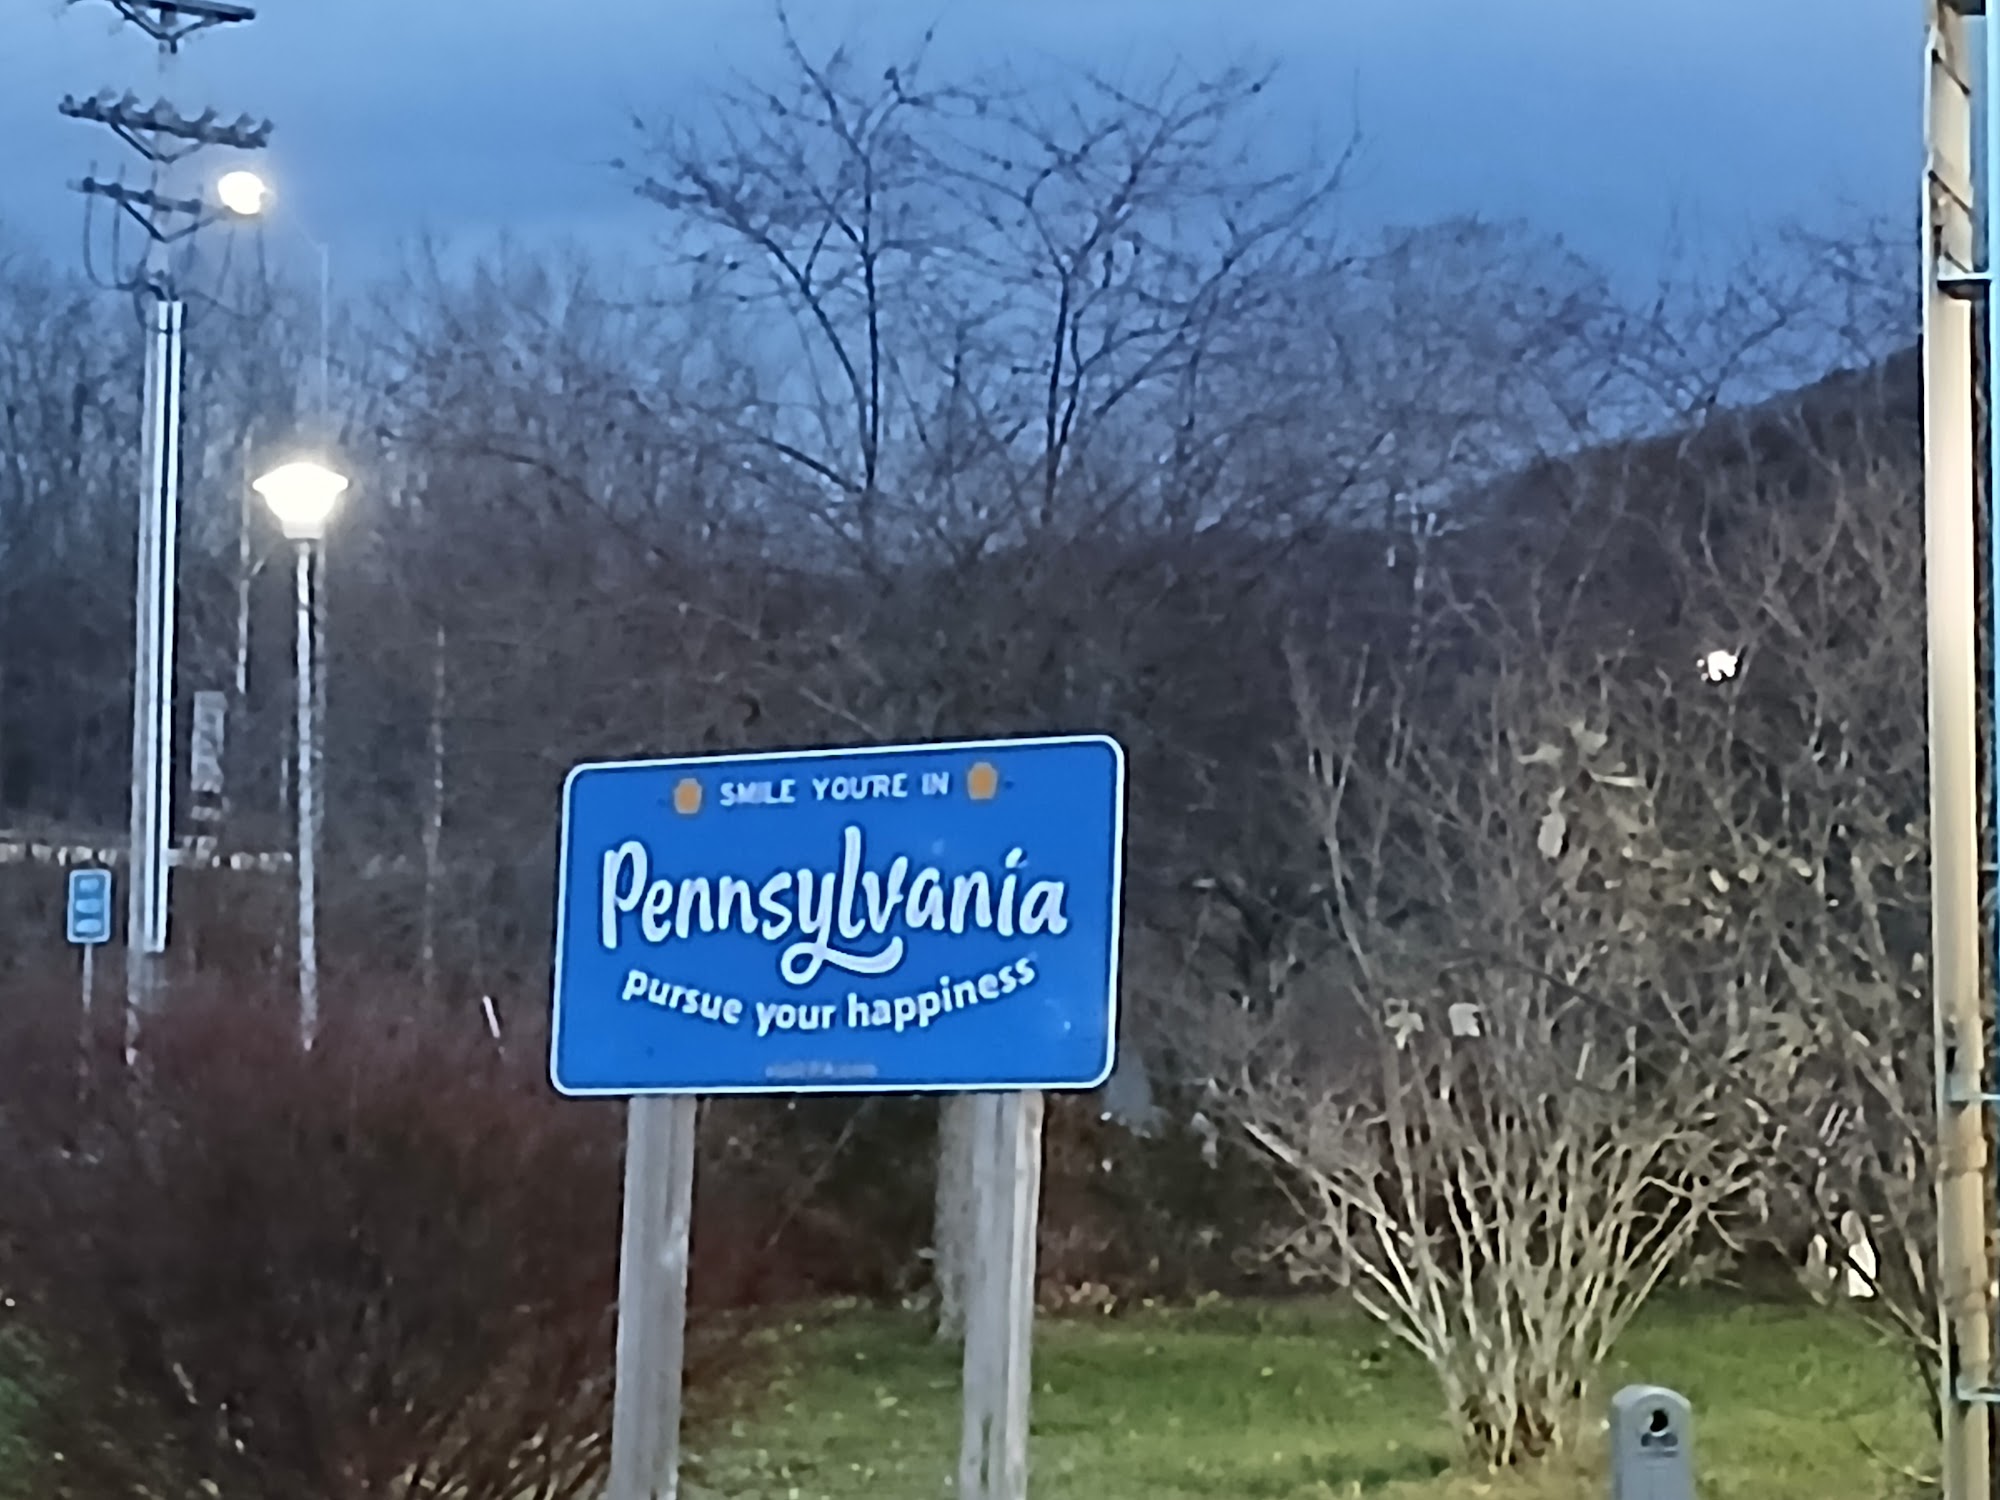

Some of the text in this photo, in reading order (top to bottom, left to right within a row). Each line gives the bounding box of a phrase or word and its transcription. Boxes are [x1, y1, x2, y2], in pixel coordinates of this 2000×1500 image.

[720, 779, 796, 806] SMILE
[921, 772, 950, 796] IN
[602, 827, 1068, 984] Pennsylvania
[622, 956, 1036, 1036] pursue your happiness
